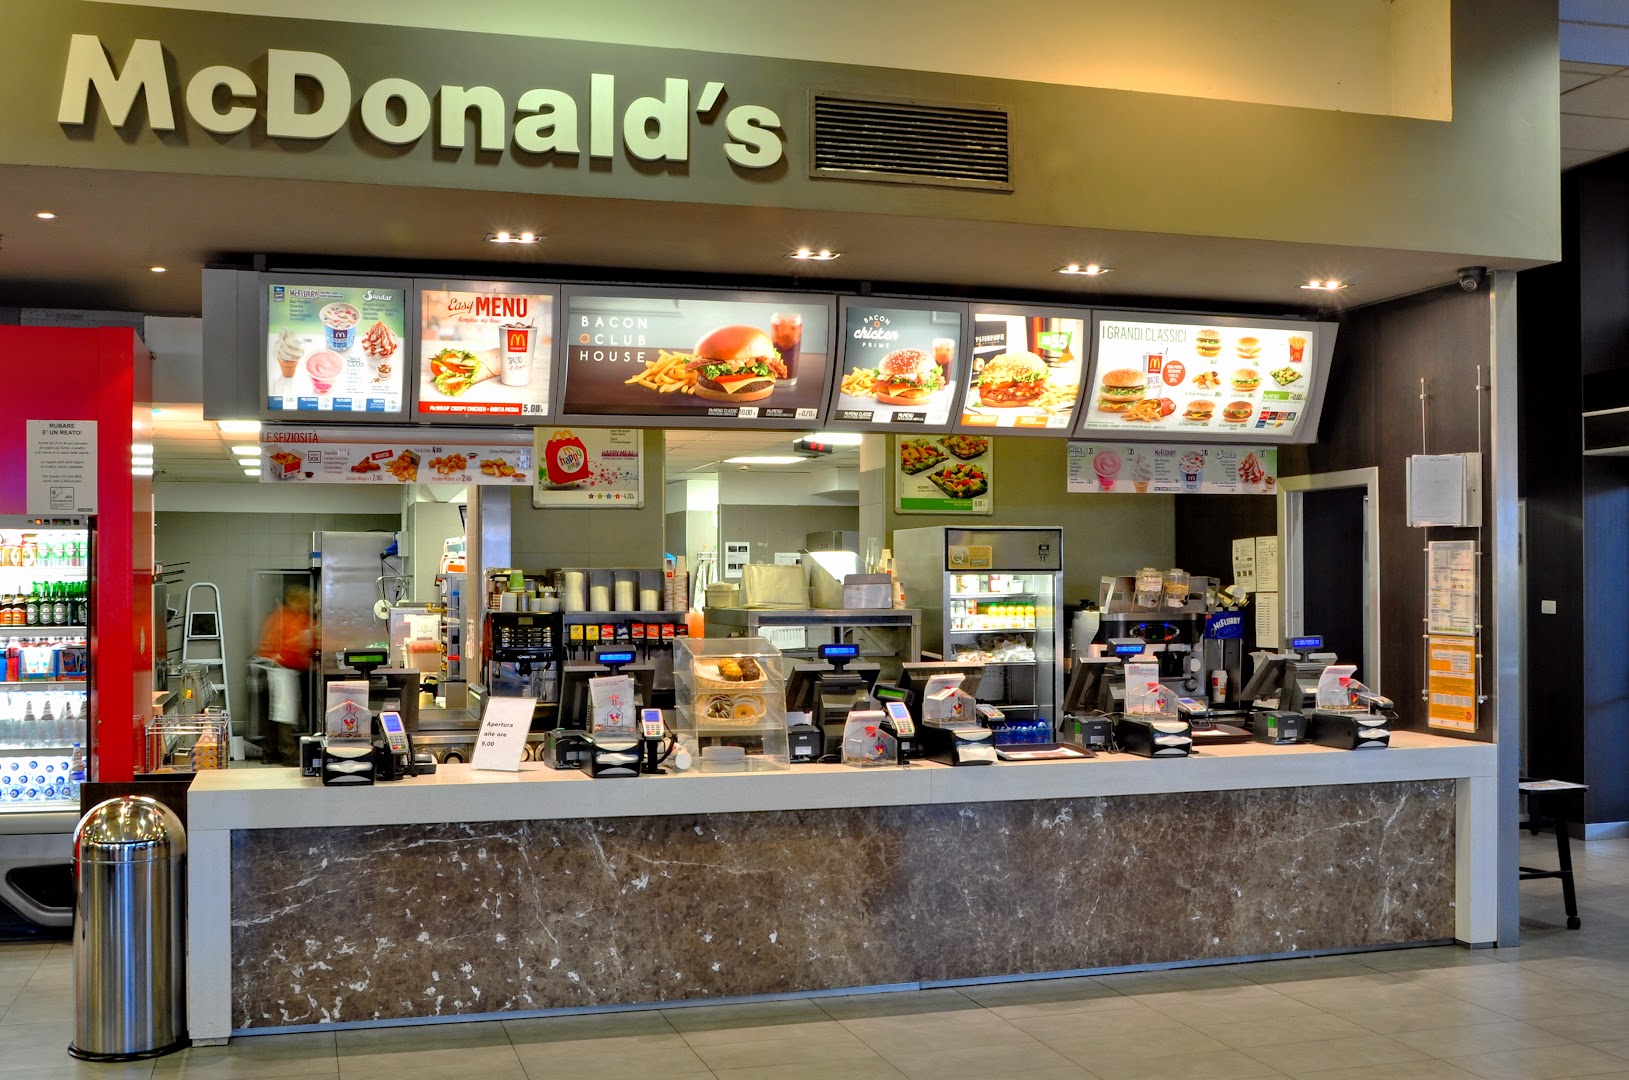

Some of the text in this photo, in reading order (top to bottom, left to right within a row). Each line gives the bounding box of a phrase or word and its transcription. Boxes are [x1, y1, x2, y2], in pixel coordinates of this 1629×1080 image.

[57, 33, 784, 169] McDonald's
[448, 296, 528, 318] Easy MENU
[581, 315, 648, 329] BACON
[863, 314, 891, 325] BACON
[595, 333, 646, 346] CLUB
[854, 327, 899, 340] chicken
[1107, 326, 1143, 341] GRANDI
[1145, 328, 1187, 343] CLASSICI
[580, 350, 645, 363] HOUSE
[262, 430, 319, 443] LE SFIZIOSITÀ
[952, 551, 964, 565] Q
